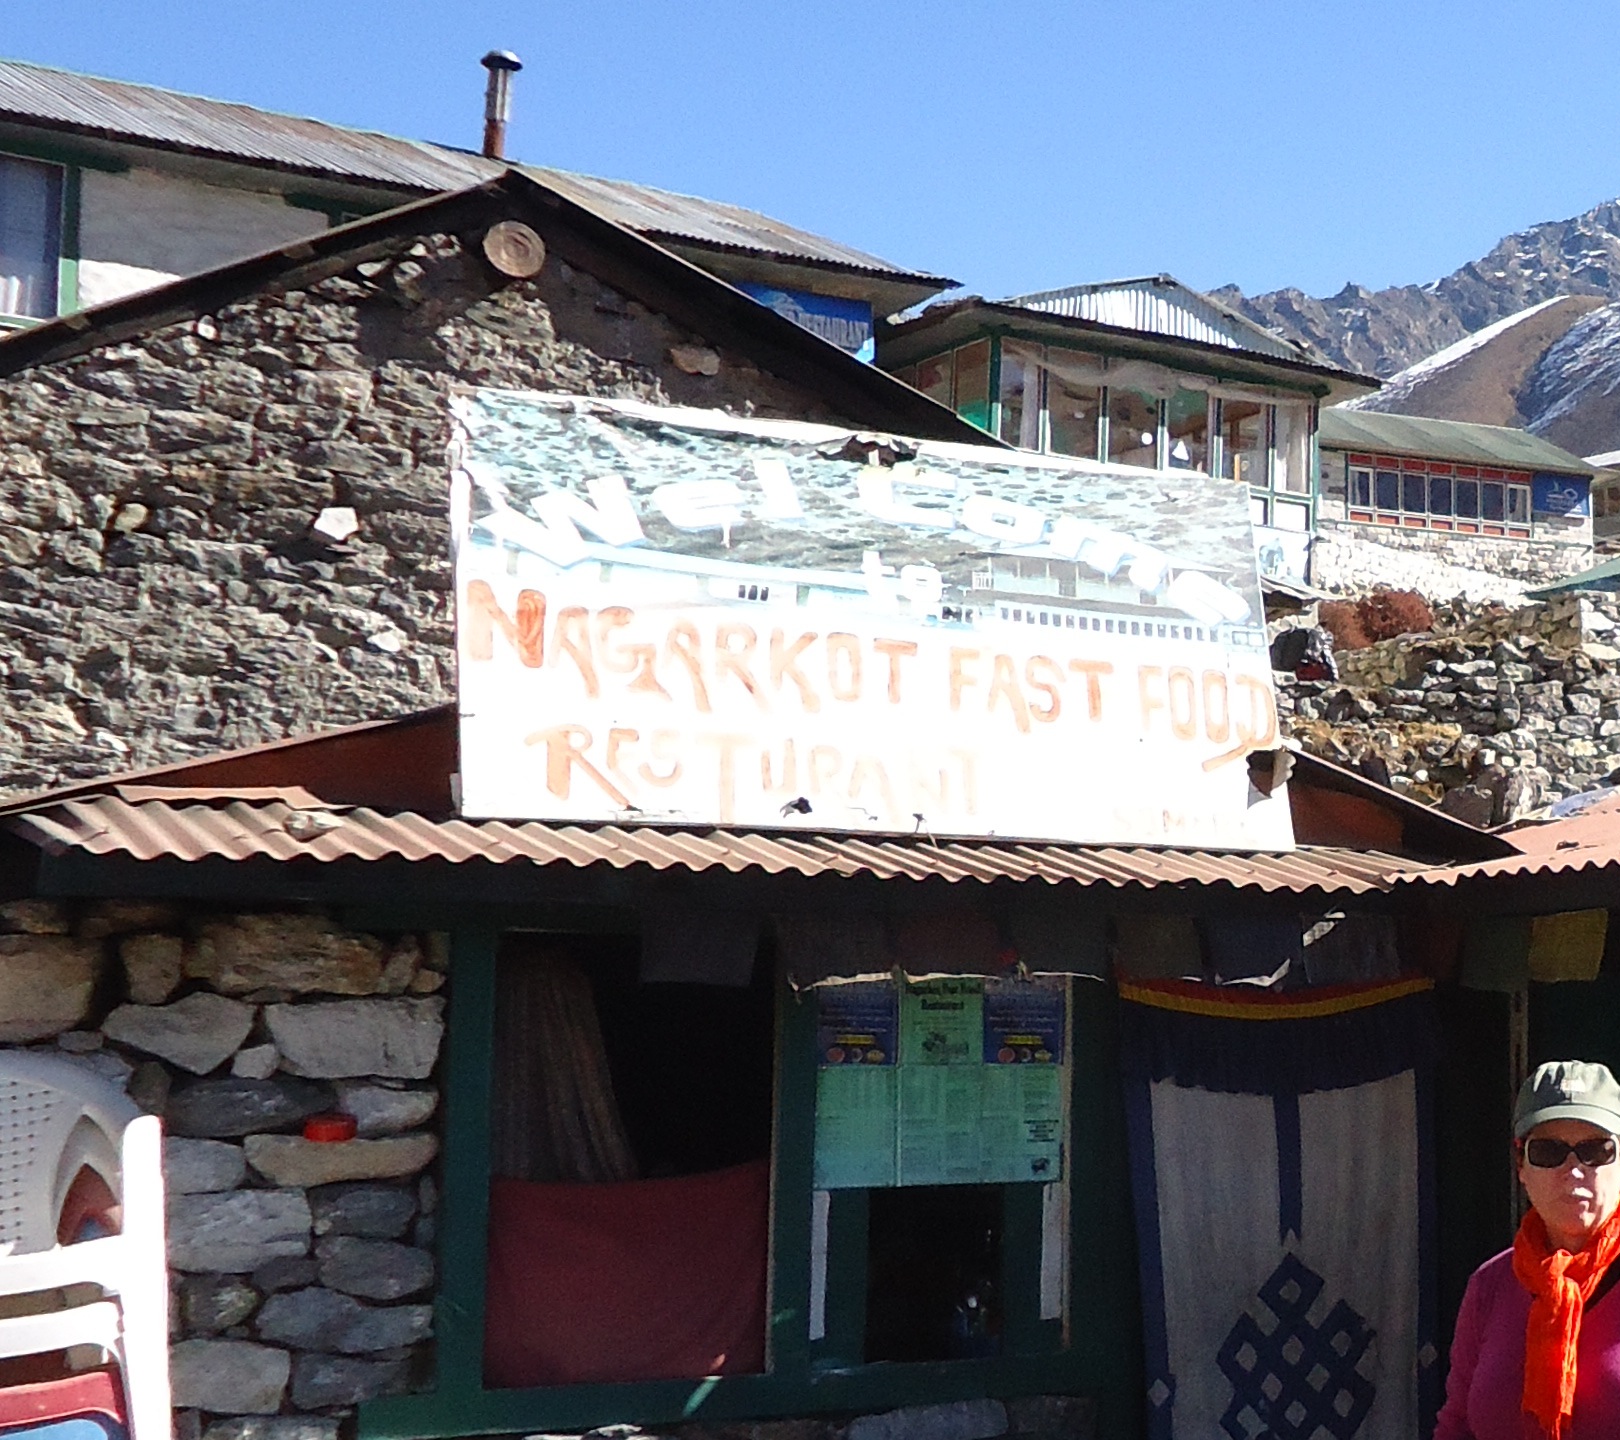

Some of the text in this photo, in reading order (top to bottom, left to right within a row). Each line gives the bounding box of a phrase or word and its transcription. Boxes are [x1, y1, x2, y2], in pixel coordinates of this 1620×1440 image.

[467, 580, 1280, 773] NAGARKOT FAST FOOD
